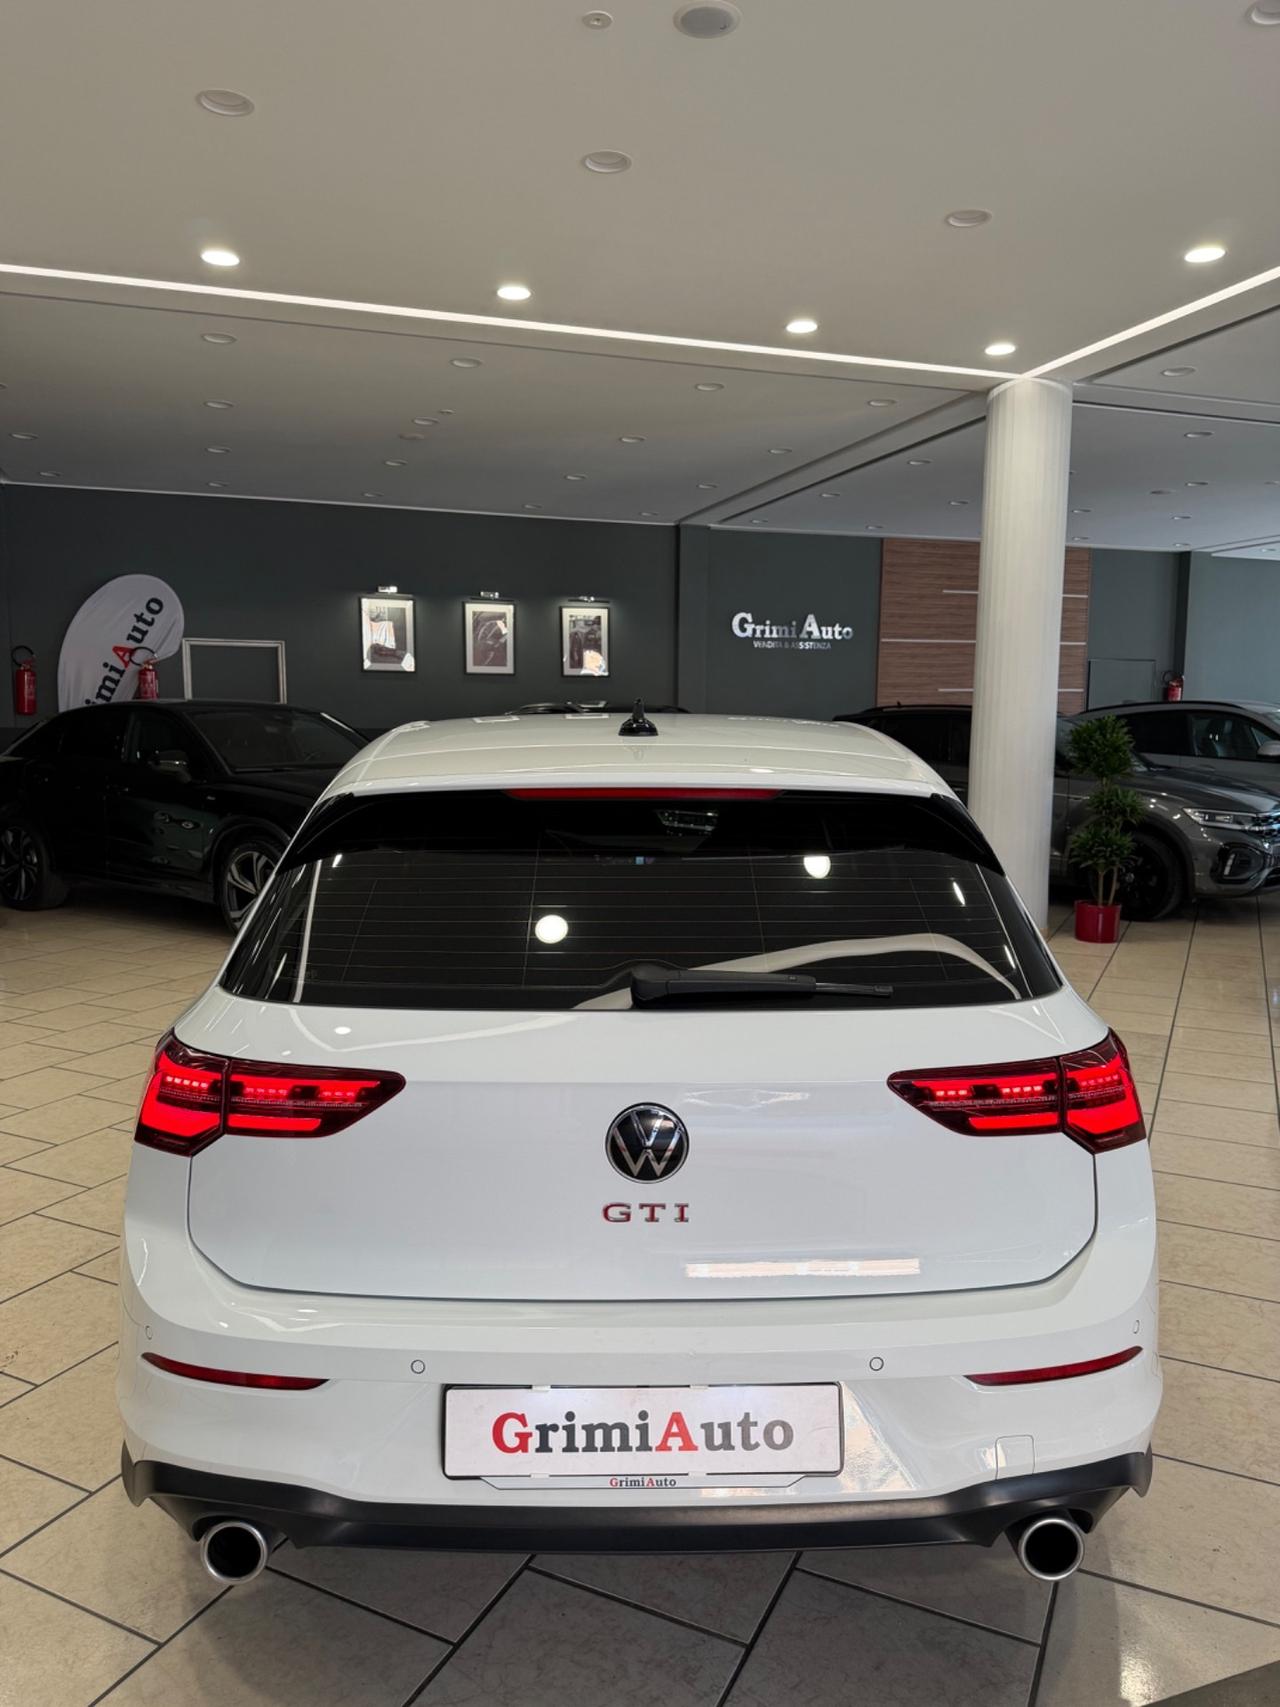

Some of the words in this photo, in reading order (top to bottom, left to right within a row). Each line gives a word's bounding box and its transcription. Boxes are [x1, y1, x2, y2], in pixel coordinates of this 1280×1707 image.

[610, 1106, 686, 1179] VW
[602, 1203, 690, 1223] GTI
[491, 1410, 795, 1453] GrimiAuto
[609, 1476, 677, 1488] GrimiAuto
